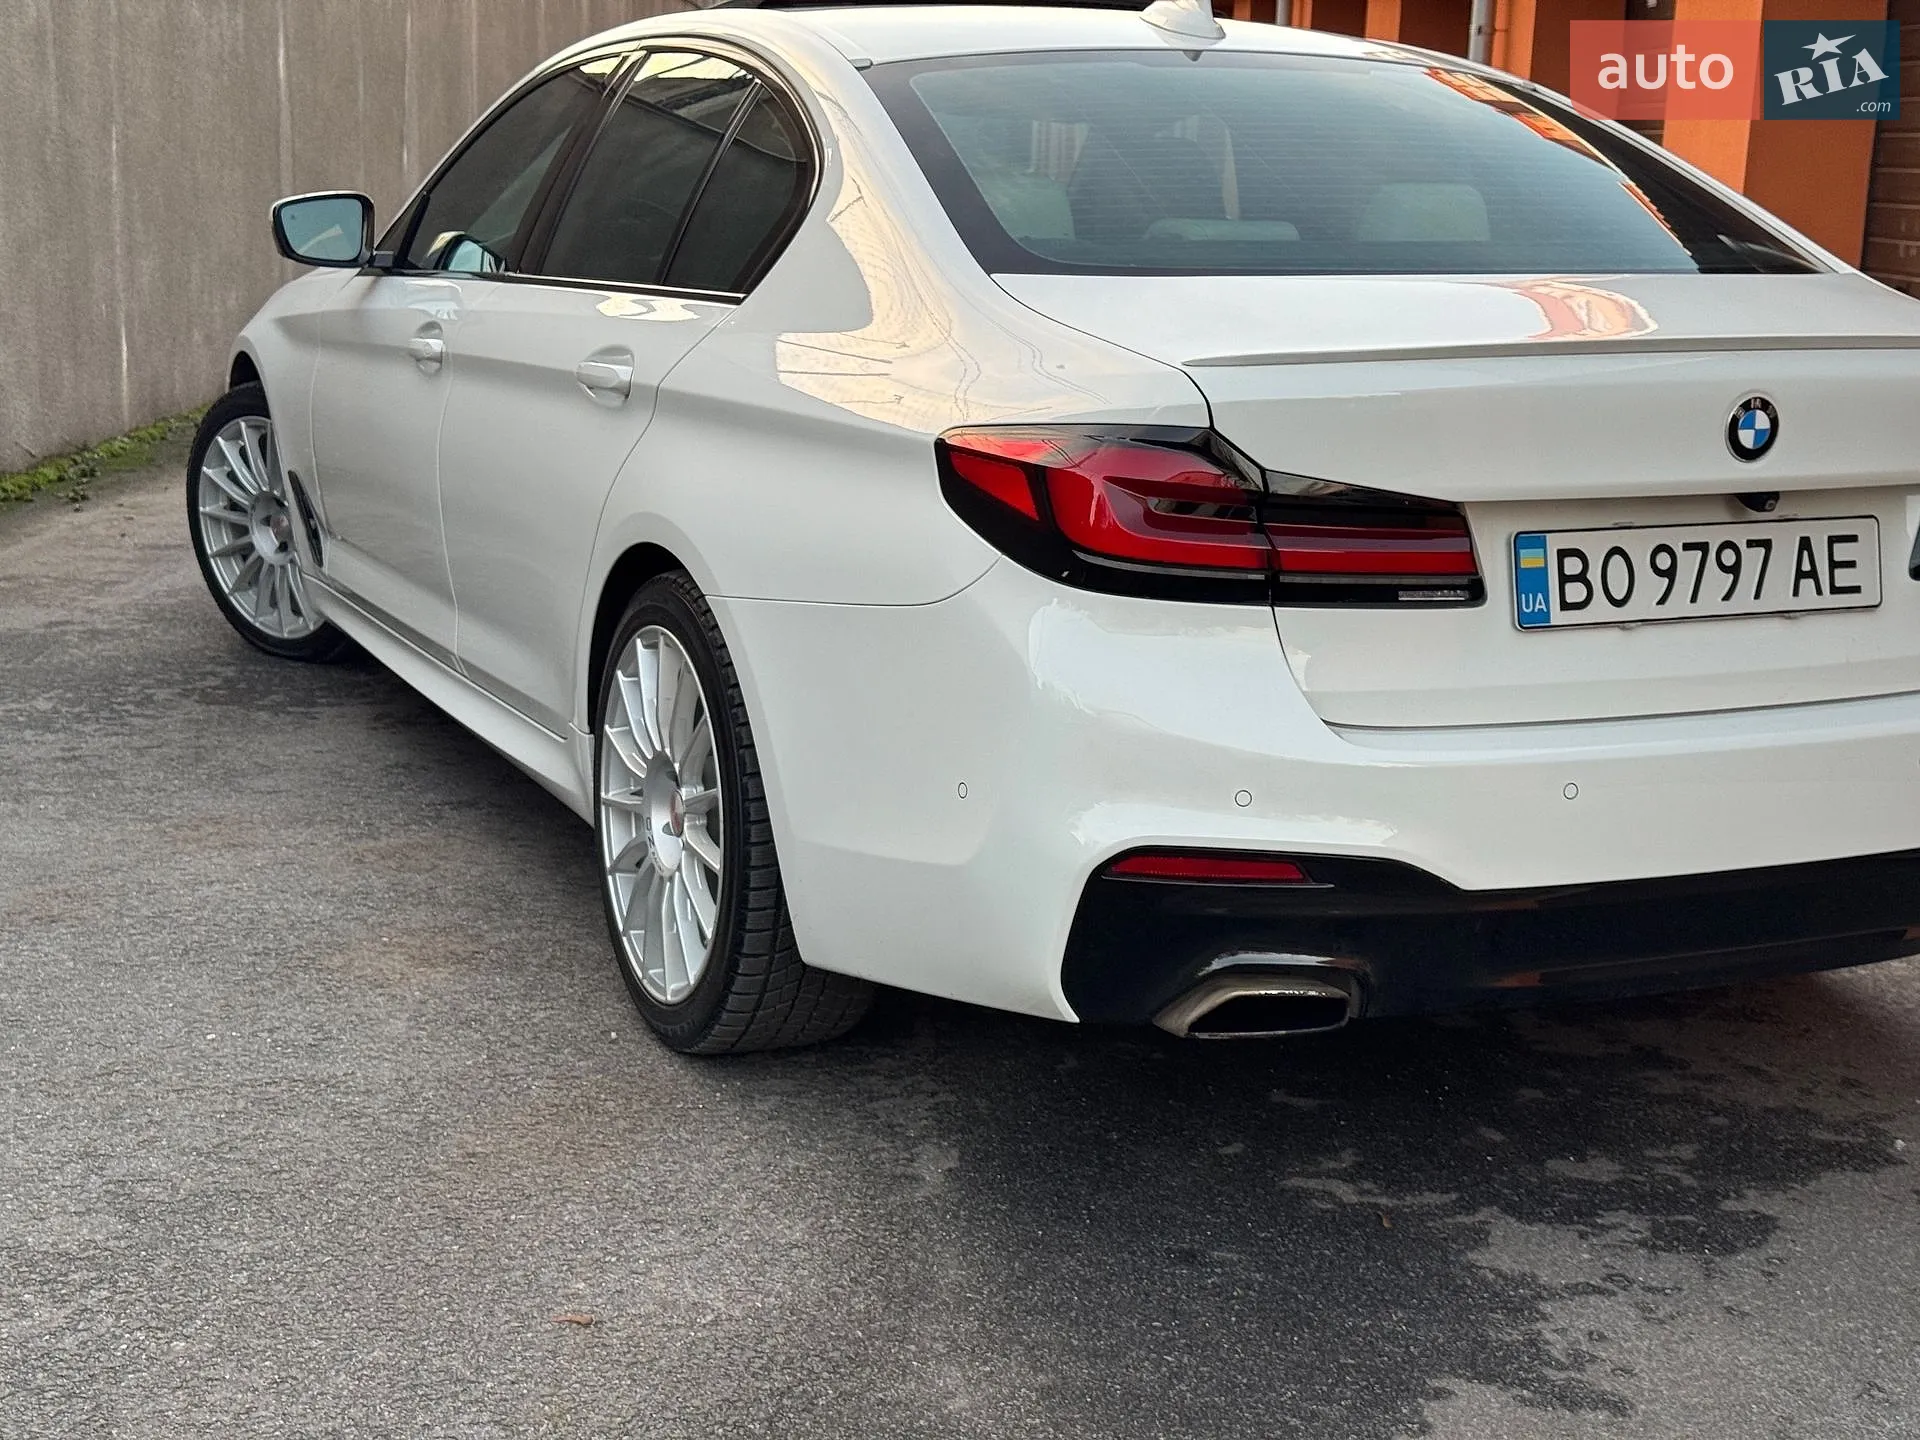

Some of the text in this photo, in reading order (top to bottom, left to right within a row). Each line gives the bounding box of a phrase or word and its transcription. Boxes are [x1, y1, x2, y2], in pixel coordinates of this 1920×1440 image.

[1556, 534, 1862, 612] BO 9797 AE
[1521, 592, 1548, 613] UA
